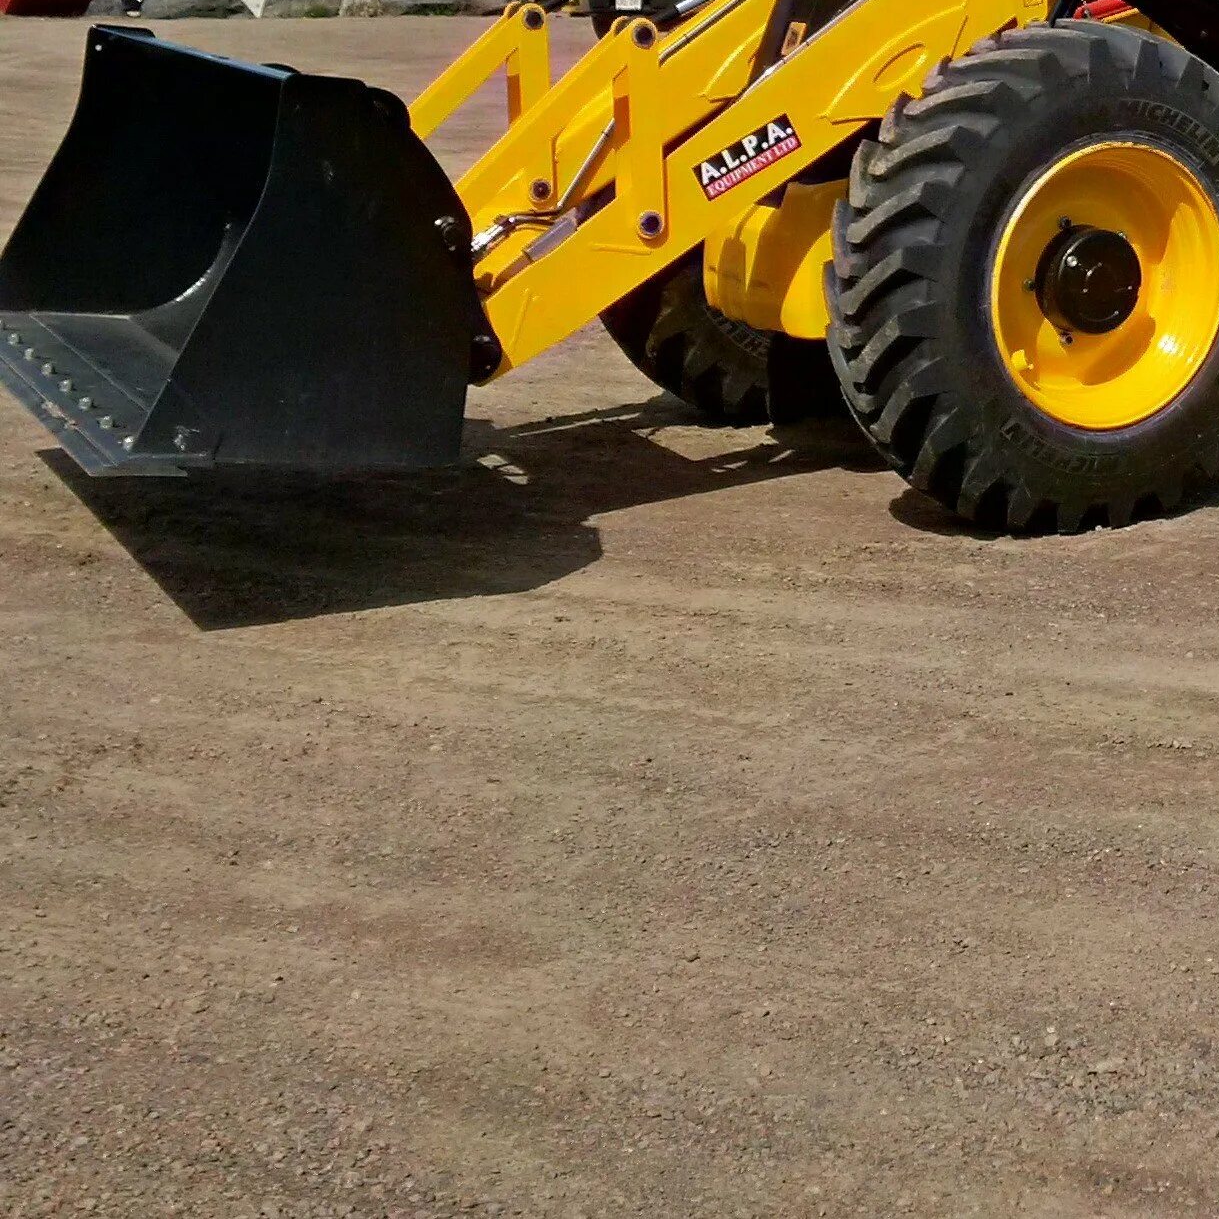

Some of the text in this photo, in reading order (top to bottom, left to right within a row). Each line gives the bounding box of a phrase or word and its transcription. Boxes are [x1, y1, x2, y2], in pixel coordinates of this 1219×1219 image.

[700, 122, 793, 185] A.L.P.A.
[706, 135, 798, 196] EQUIPMENT LTD
